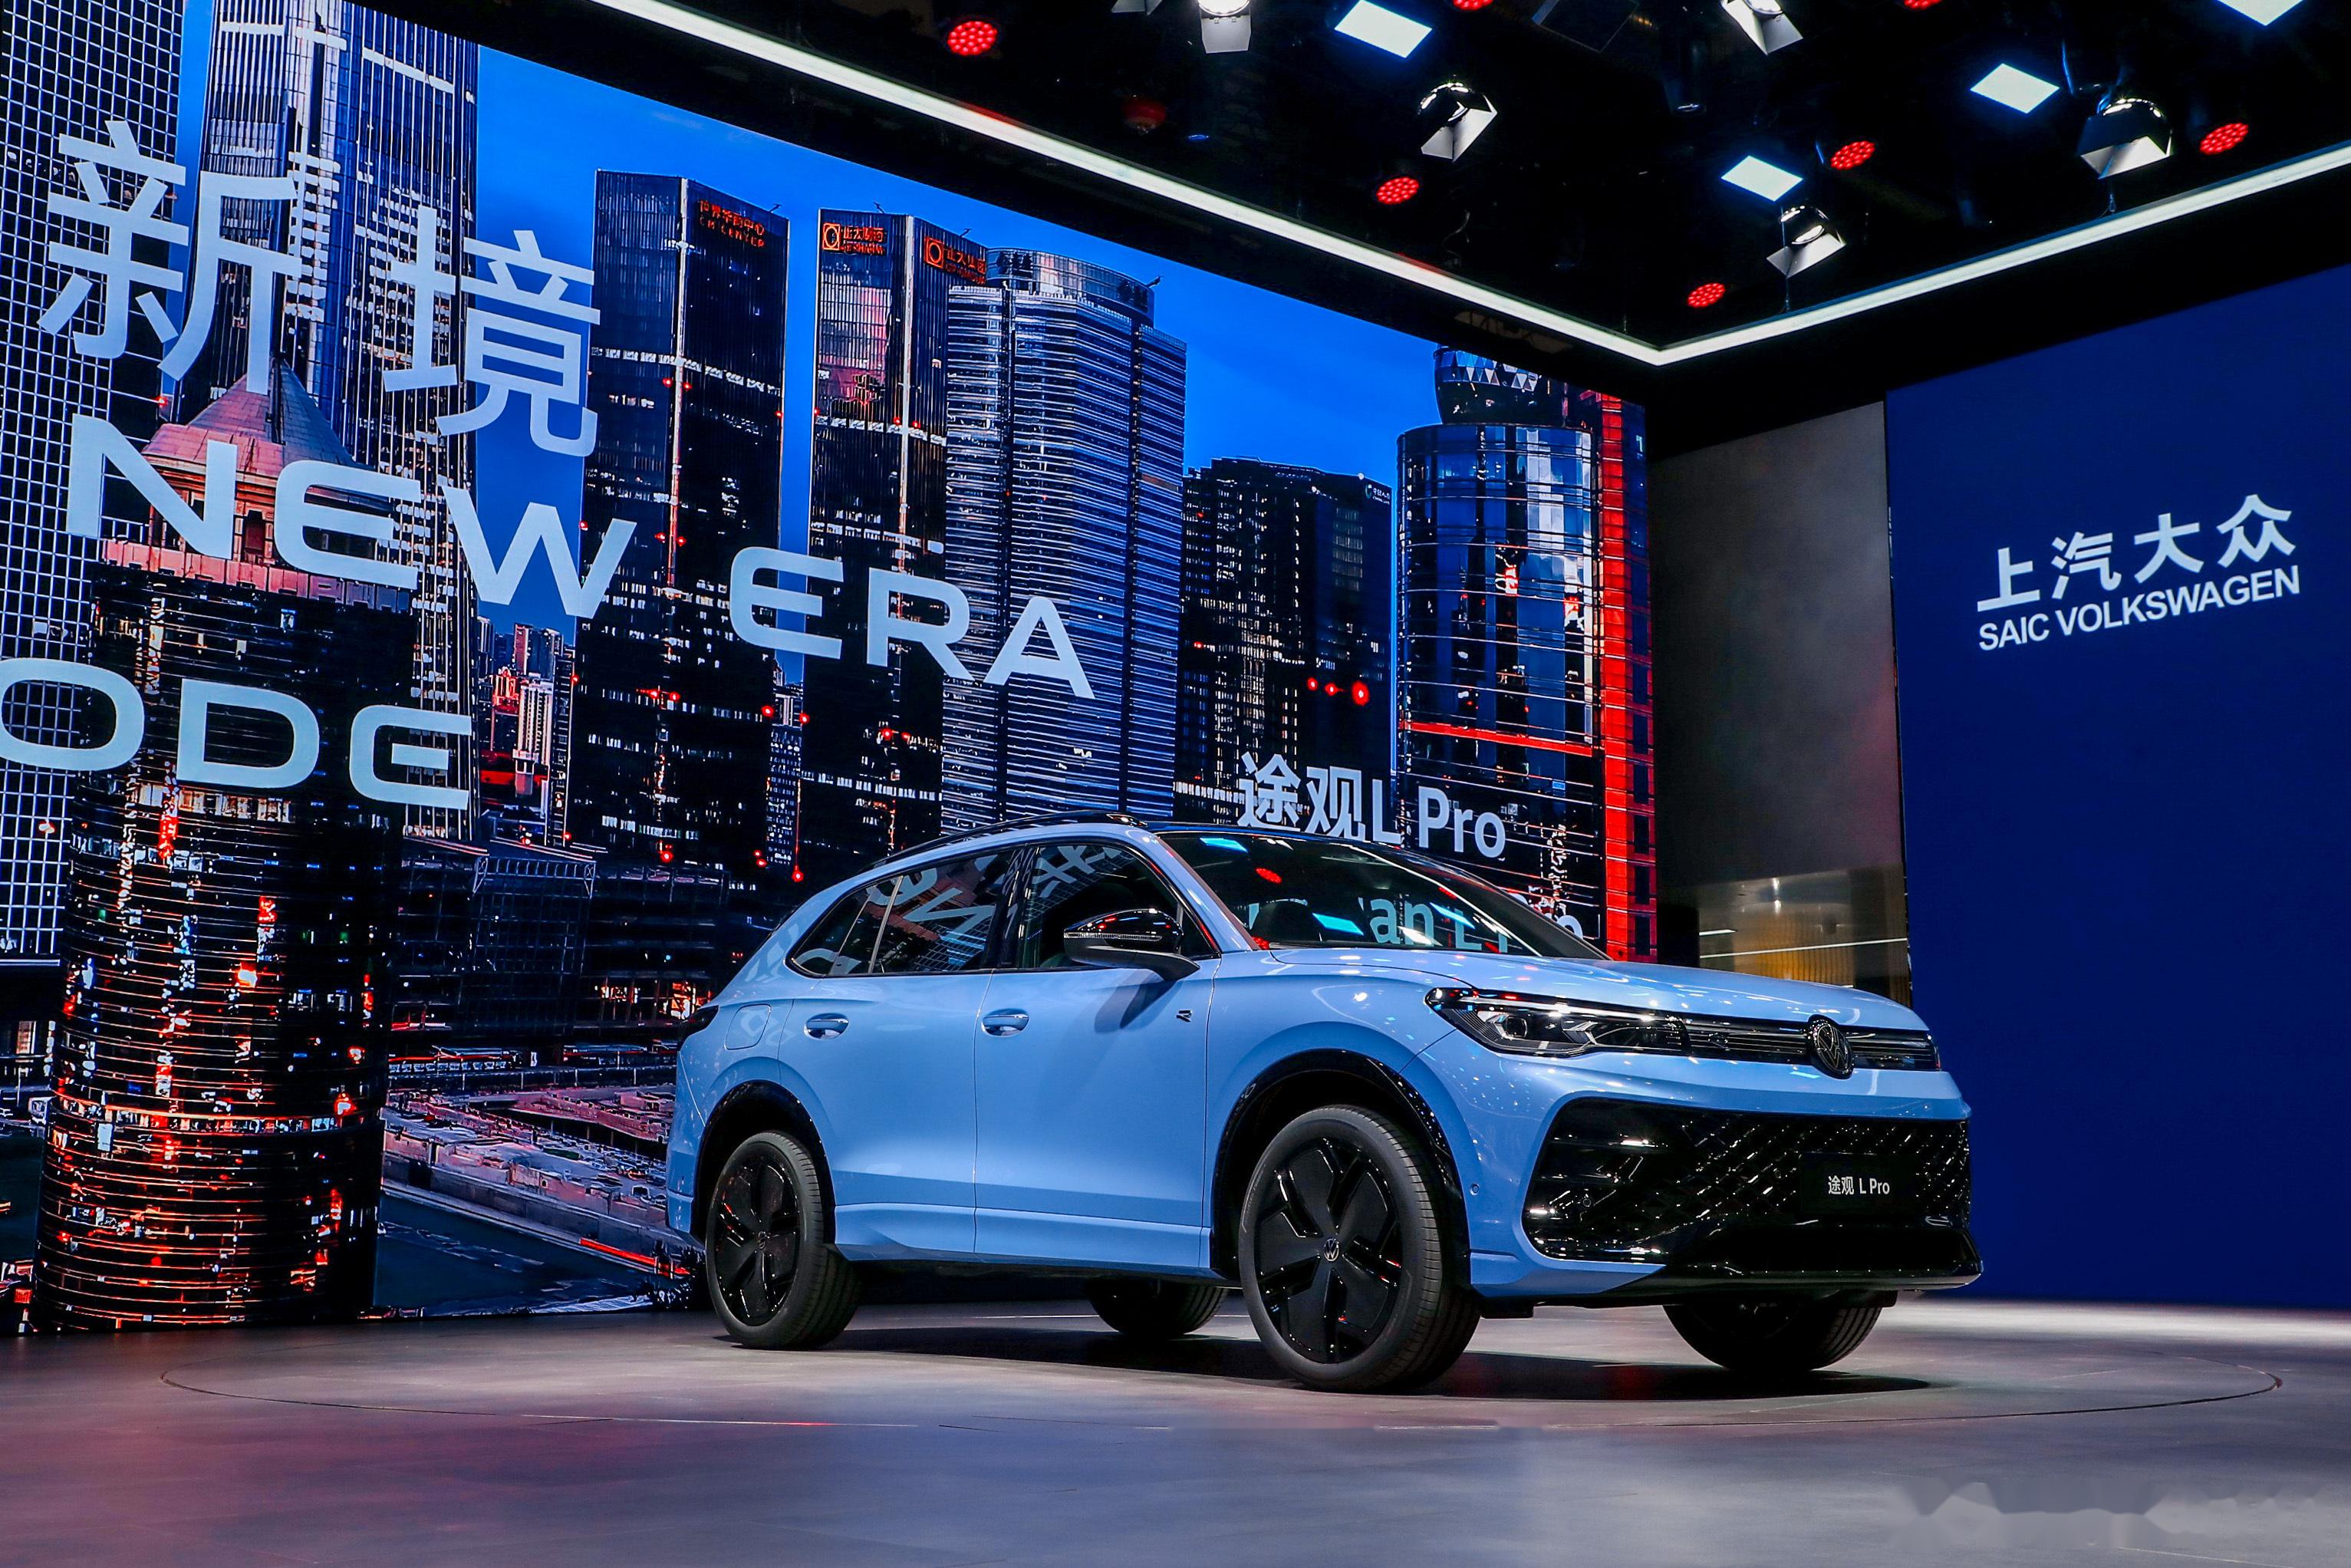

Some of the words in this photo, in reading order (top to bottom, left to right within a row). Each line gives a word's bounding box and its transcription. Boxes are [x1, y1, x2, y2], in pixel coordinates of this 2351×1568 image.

[37, 120, 601, 458] 新境
[66, 413, 637, 619] NEW
[729, 546, 1095, 699] ERA
[1977, 493, 2296, 612] 上汽大众
[1979, 613, 2050, 651] SAIC
[2055, 565, 2300, 637] VOLKSWAGEN
[0, 657, 473, 811] ODE
[1418, 786, 1507, 859] Pro
[1828, 1175, 1855, 1195] 途观
[1859, 1178, 1867, 1194] L
[1869, 1178, 1891, 1195] Pro
